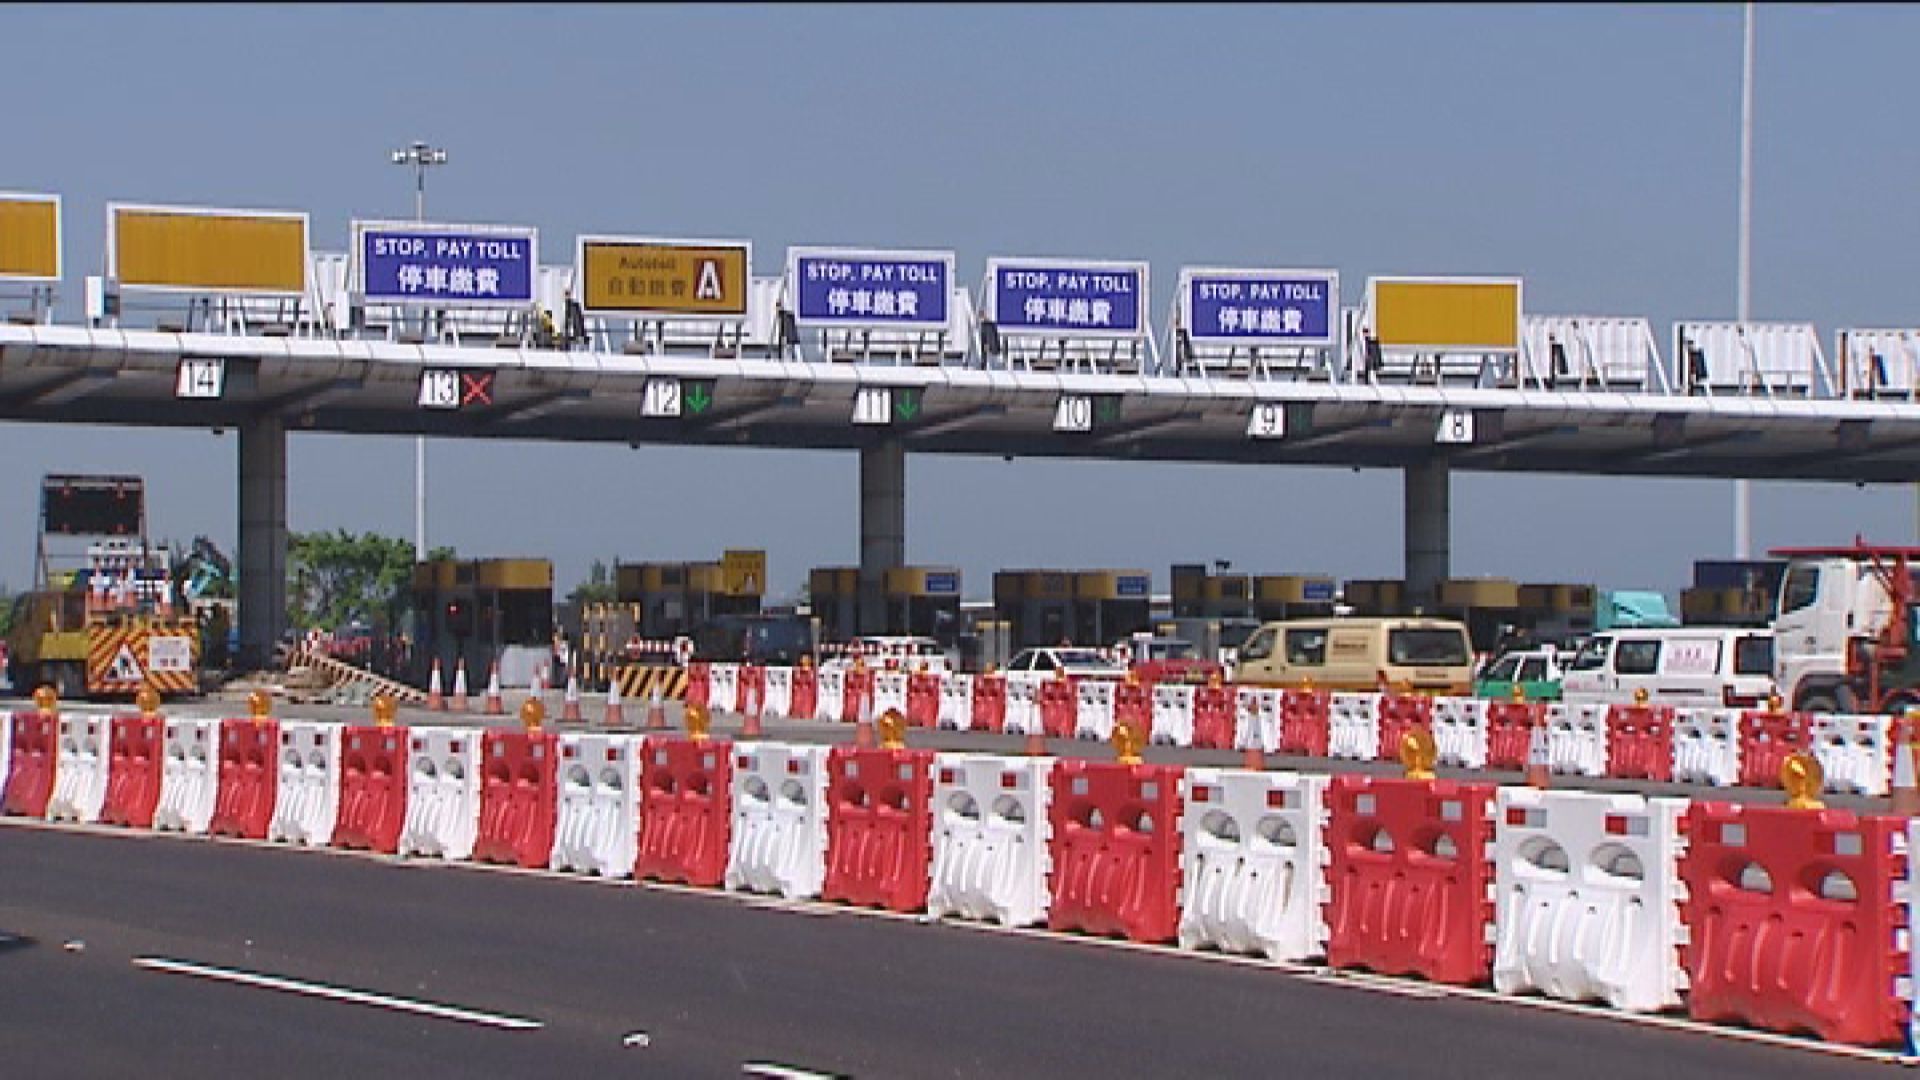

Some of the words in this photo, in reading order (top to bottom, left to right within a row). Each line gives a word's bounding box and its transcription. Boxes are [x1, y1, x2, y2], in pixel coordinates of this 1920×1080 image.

[437, 238, 472, 258] PAY
[476, 241, 521, 259] TOLL
[696, 259, 722, 300] A
[861, 263, 894, 282] PAY
[898, 264, 937, 283] TOLL
[1058, 272, 1089, 291] PAY
[1092, 275, 1131, 293] TOLL
[1250, 283, 1281, 300] PAY
[1283, 284, 1321, 300] TOLL
[187, 360, 215, 394] 14
[428, 370, 456, 405] 13
[652, 380, 678, 413] 12
[865, 388, 885, 422] 11
[1064, 396, 1090, 429] 10
[1260, 402, 1276, 436] 9
[1451, 410, 1466, 440] 8
